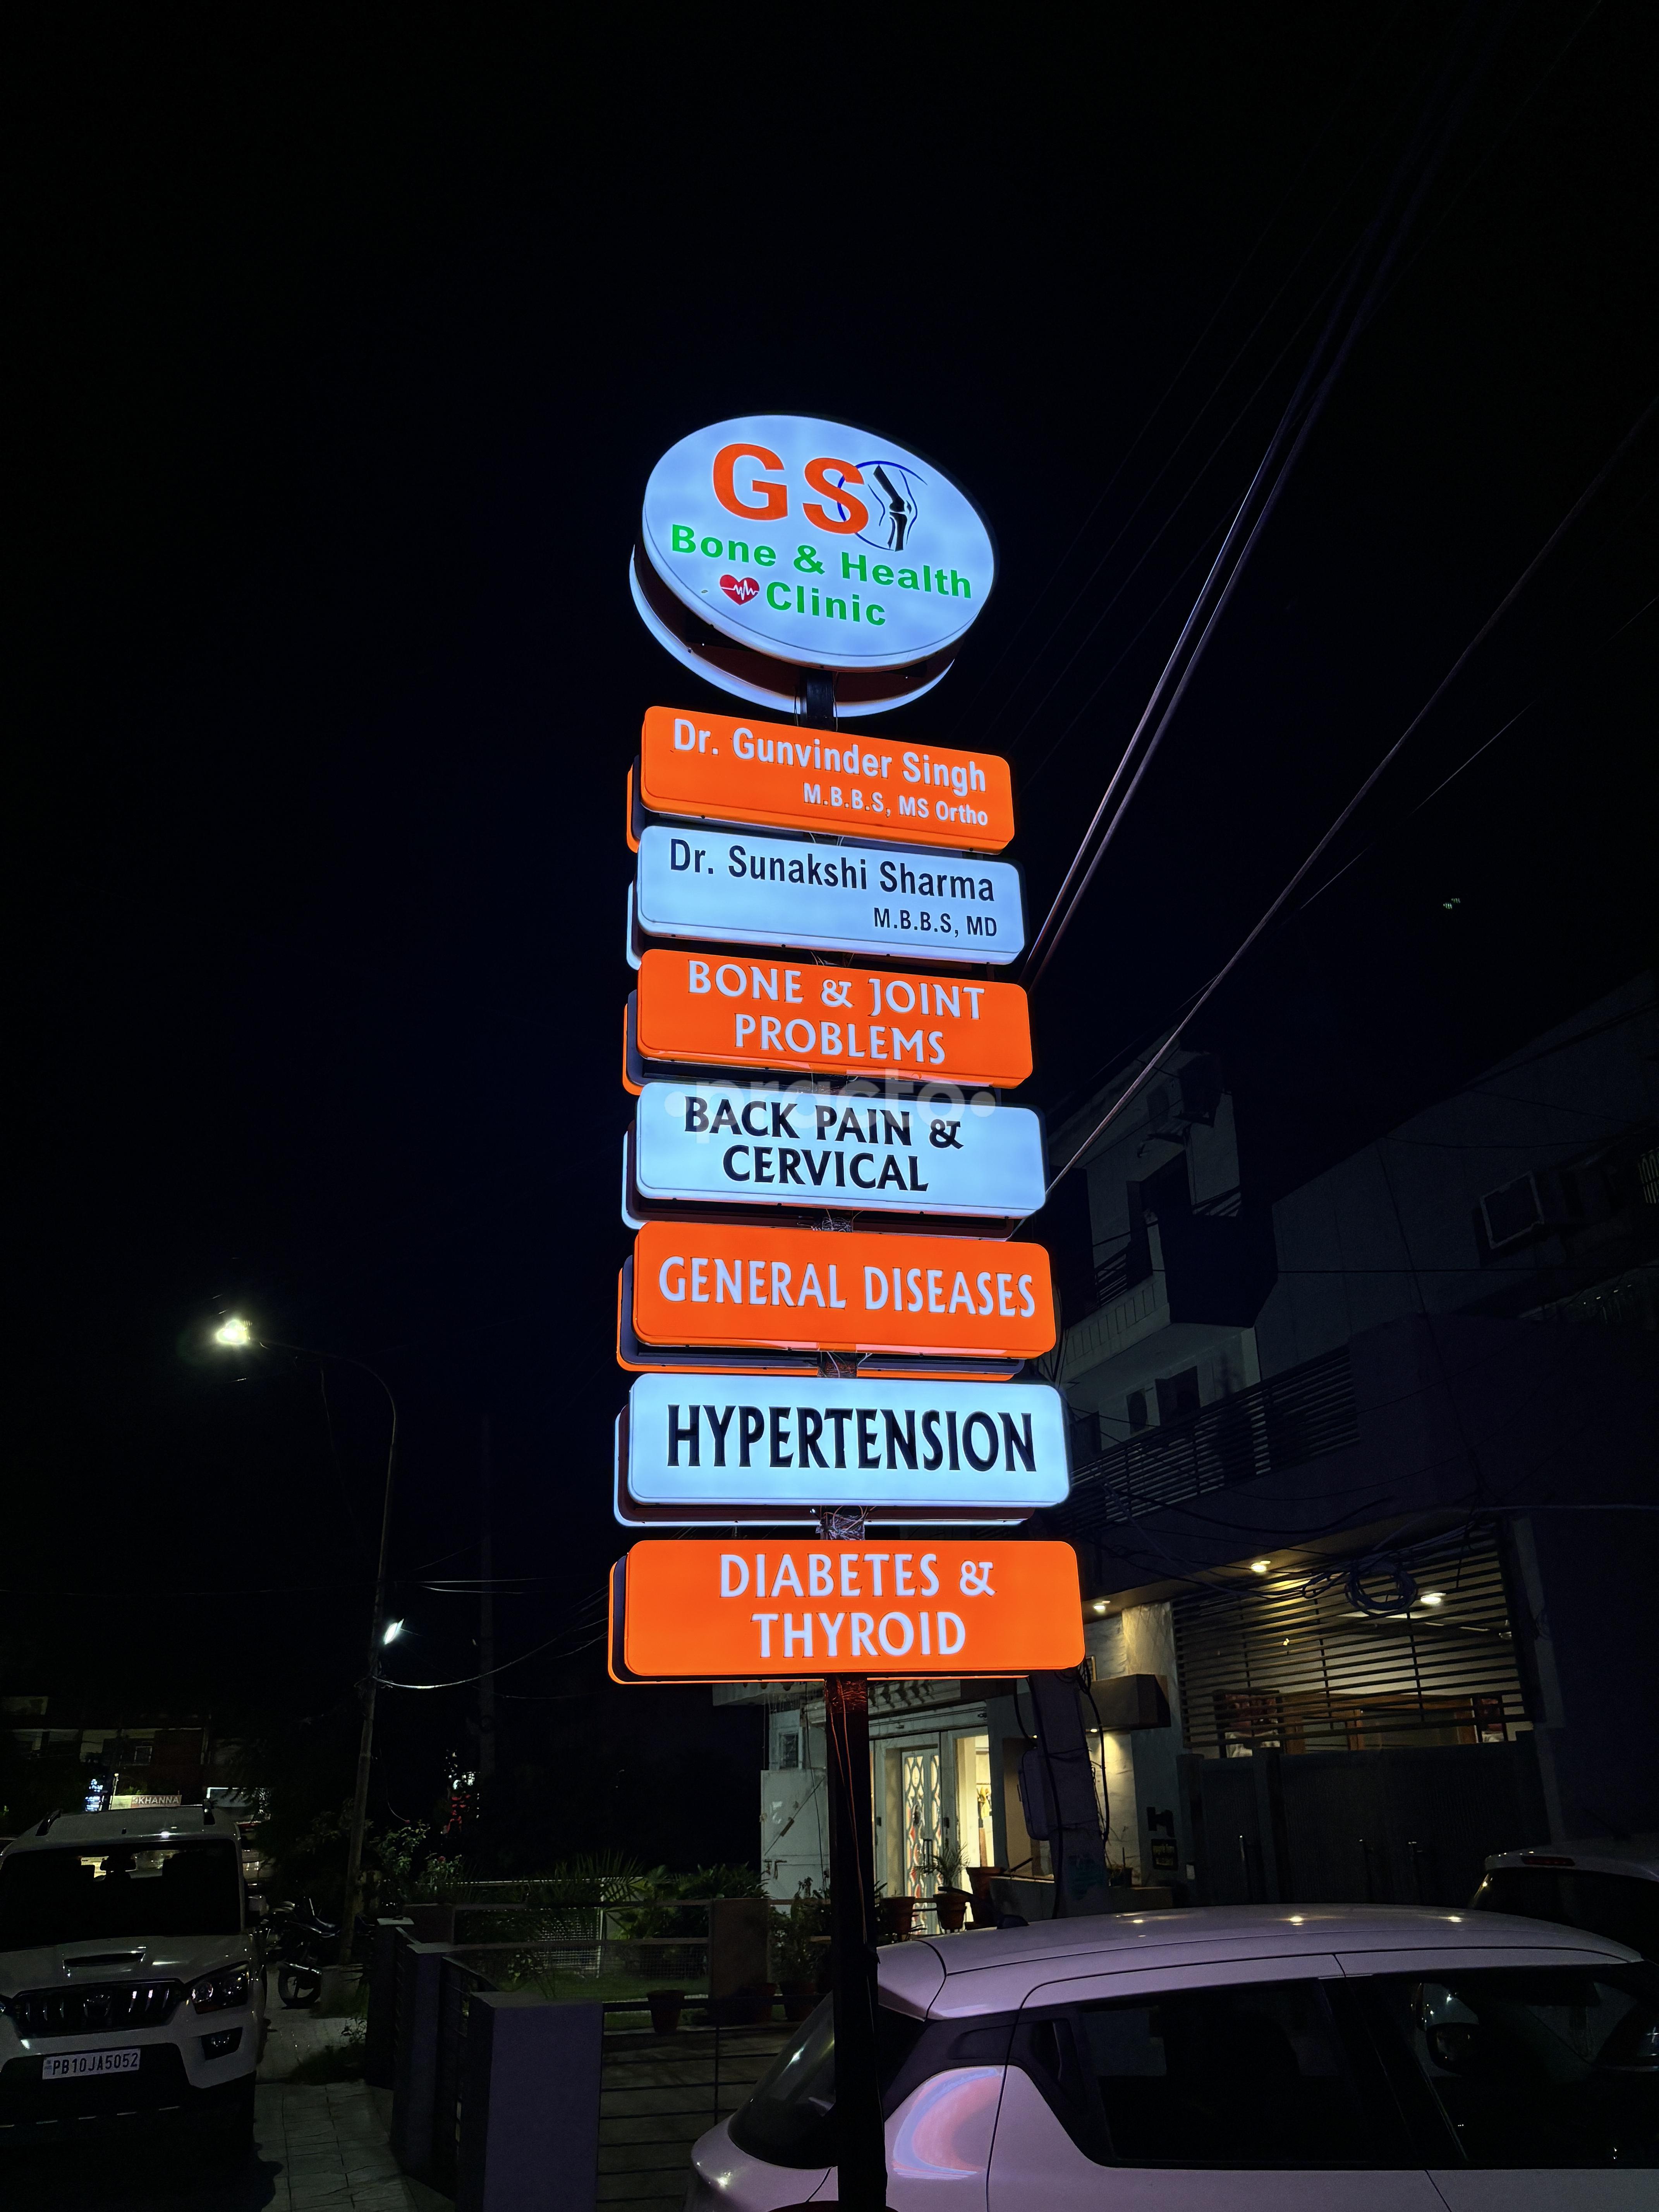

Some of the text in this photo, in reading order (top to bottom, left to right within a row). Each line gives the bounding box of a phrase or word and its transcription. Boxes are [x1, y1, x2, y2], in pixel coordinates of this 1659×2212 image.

[713, 444, 867, 534] GS
[672, 524, 970, 600] Bone & Health
[766, 582, 886, 626] Clinic
[674, 718, 986, 797] Dr. Gunvinder Singh
[804, 783, 988, 826] M.B.B.S, MS Ortho
[671, 839, 994, 901] Dr. Sunakshi Sharma
[874, 907, 997, 938] M.B.B.S, MD
[689, 960, 984, 1020] BONE & JOINT
[735, 1013, 945, 1065] PROBLEMS
[685, 1096, 964, 1149] BACK PAIN &
[723, 1145, 929, 1192] CERVICAL
[659, 1256, 1035, 1317] GENERAL DISEASES
[667, 1405, 1036, 1472] HYPERTENSION
[720, 1553, 995, 1597] DIABETES &
[752, 1612, 966, 1657] THYROID
[52, 2052, 138, 2075] PB10JA5052
